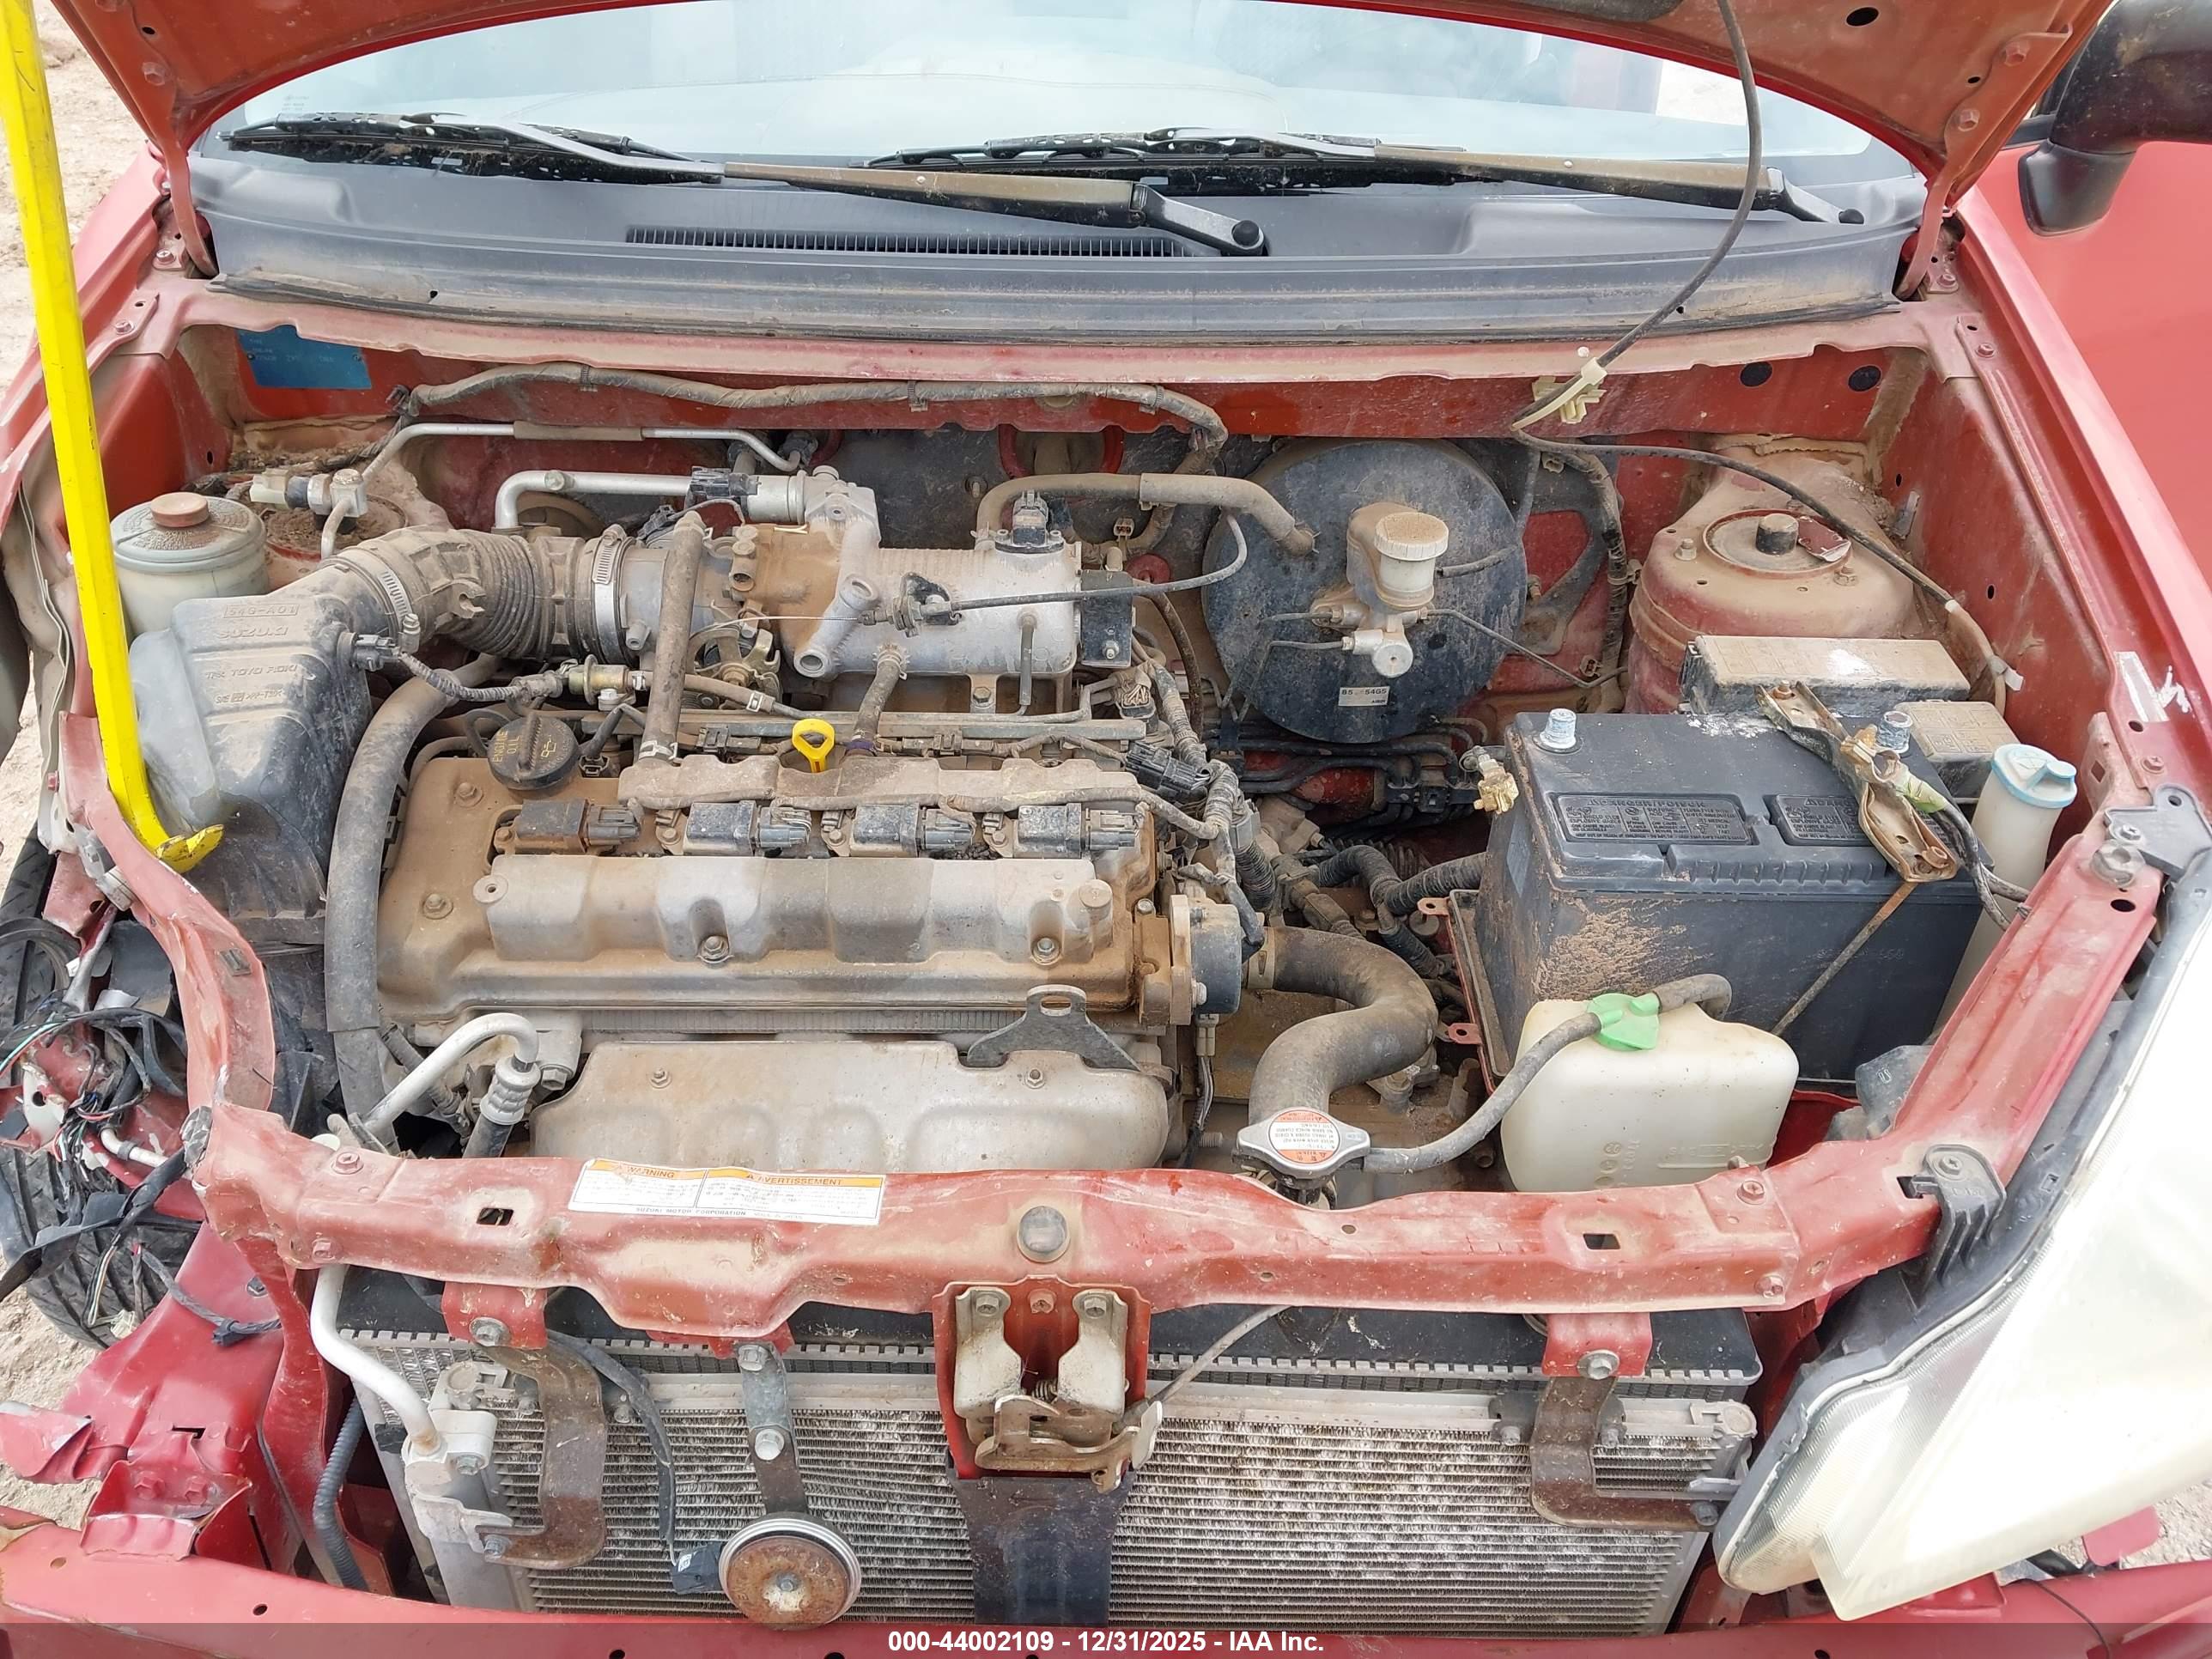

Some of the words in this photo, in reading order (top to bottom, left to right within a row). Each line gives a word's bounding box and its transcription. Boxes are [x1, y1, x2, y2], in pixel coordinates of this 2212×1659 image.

[218, 627, 289, 638] SUZUKI
[492, 729, 508, 763] ENGINE
[507, 735, 520, 754] OIL
[627, 1166, 675, 1179] WARNING
